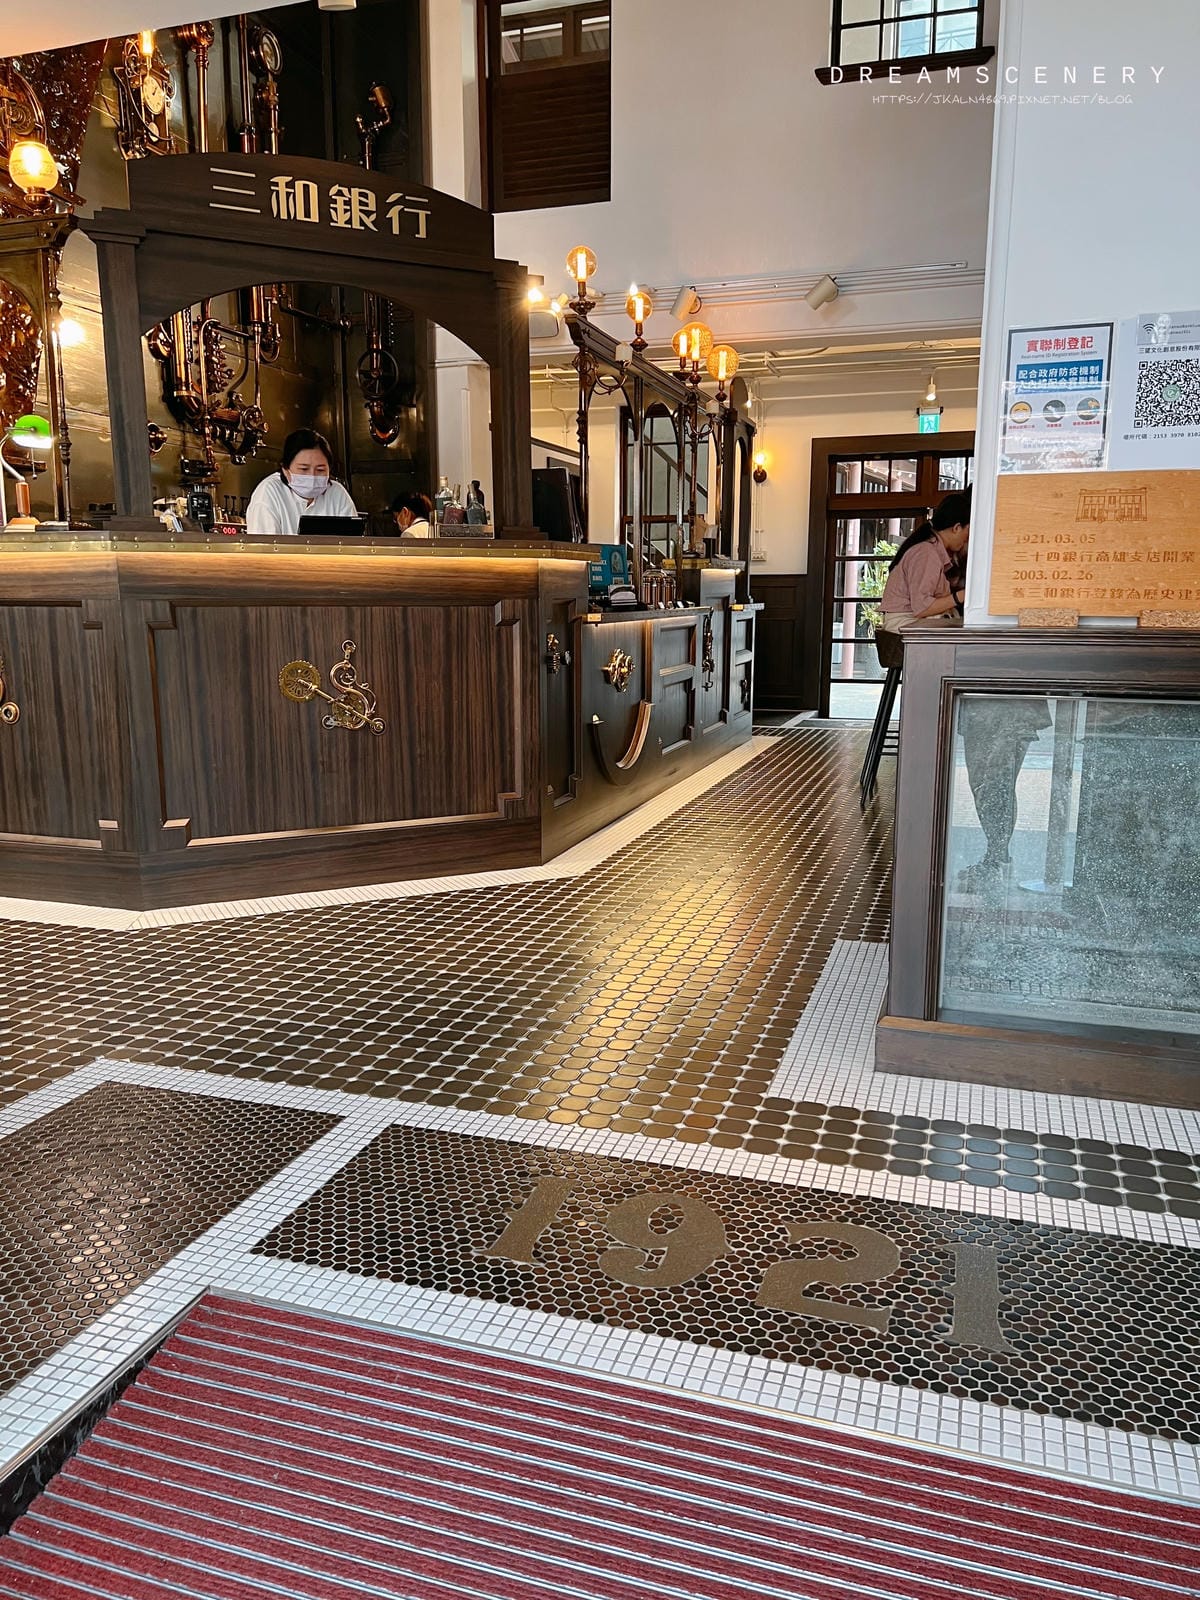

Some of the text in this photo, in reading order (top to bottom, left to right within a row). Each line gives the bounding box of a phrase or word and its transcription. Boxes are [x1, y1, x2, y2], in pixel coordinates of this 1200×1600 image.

[209, 167, 431, 239] 三和銀行
[1027, 336, 1094, 352] 實聯制登記
[1019, 366, 1100, 379] 配合政府防疫機制
[1014, 551, 1195, 563] 三十四銀行高雄支店開業
[474, 1175, 1020, 1356] 1921
